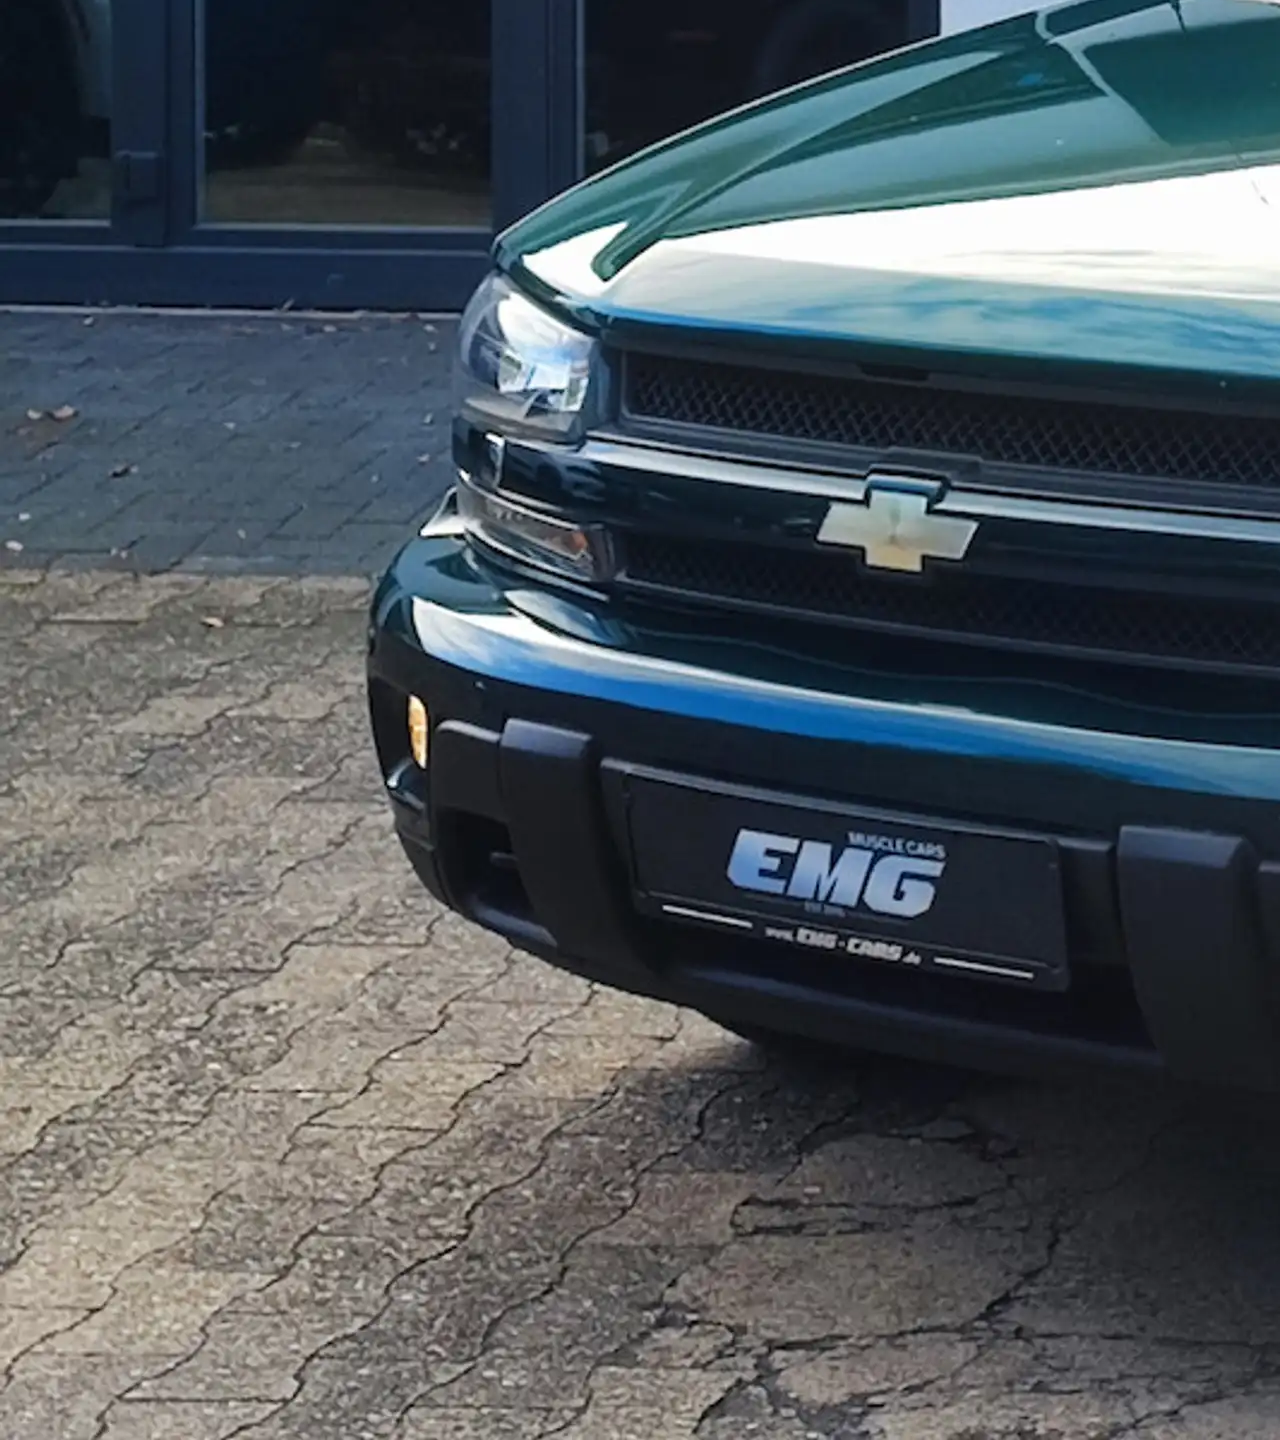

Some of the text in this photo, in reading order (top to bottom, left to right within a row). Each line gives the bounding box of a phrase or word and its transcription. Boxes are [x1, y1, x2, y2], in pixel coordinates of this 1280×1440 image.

[726, 828, 947, 918] EMG
[847, 830, 947, 860] MUSCLE CARS
